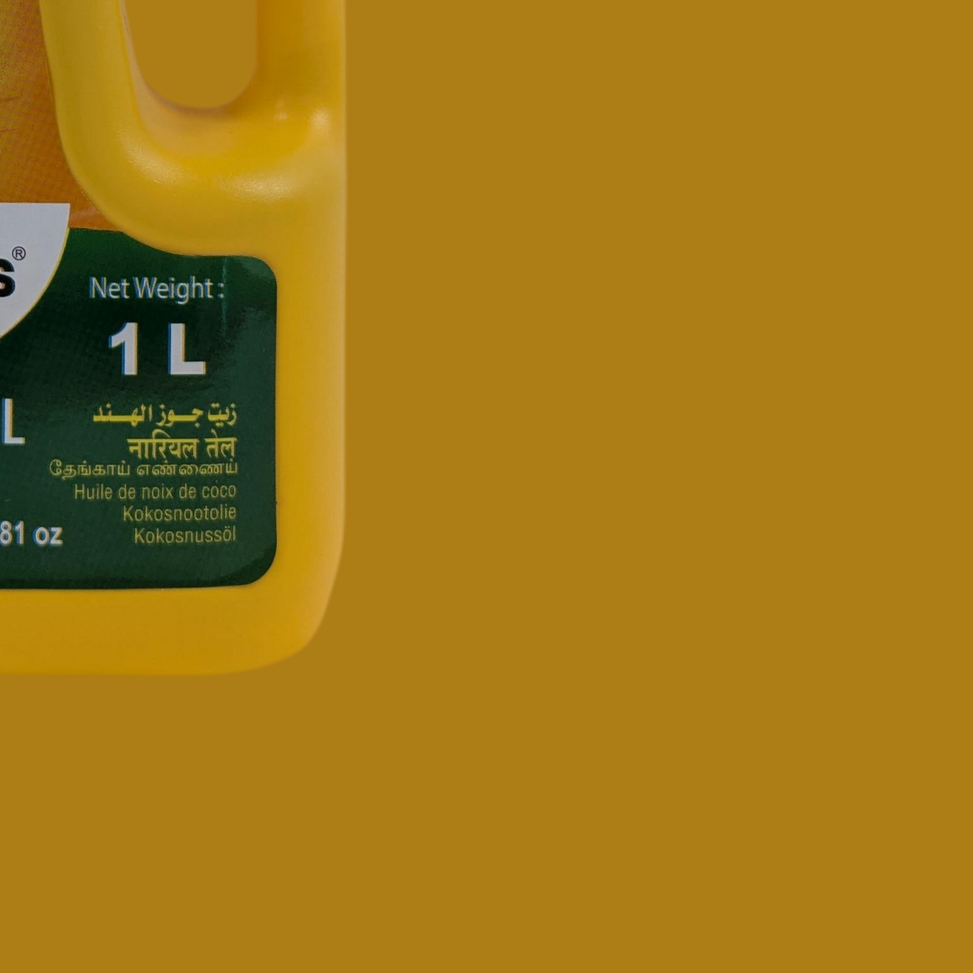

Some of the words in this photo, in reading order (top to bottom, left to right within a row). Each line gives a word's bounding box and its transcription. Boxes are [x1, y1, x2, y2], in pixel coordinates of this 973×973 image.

[90, 276, 129, 299] Net
[133, 276, 213, 304] Weight
[109, 322, 138, 375] 1
[168, 323, 206, 375] L
[128, 429, 199, 459] नारियल
[205, 429, 237, 458] तेल
[74, 483, 113, 500] Huile
[118, 484, 136, 500] de
[141, 484, 173, 500] noix
[179, 483, 197, 499] de
[202, 484, 237, 498] coco
[123, 504, 237, 521] Kokosnootolie
[33, 525, 63, 546] oz
[134, 526, 237, 544] Kokosnussöl
